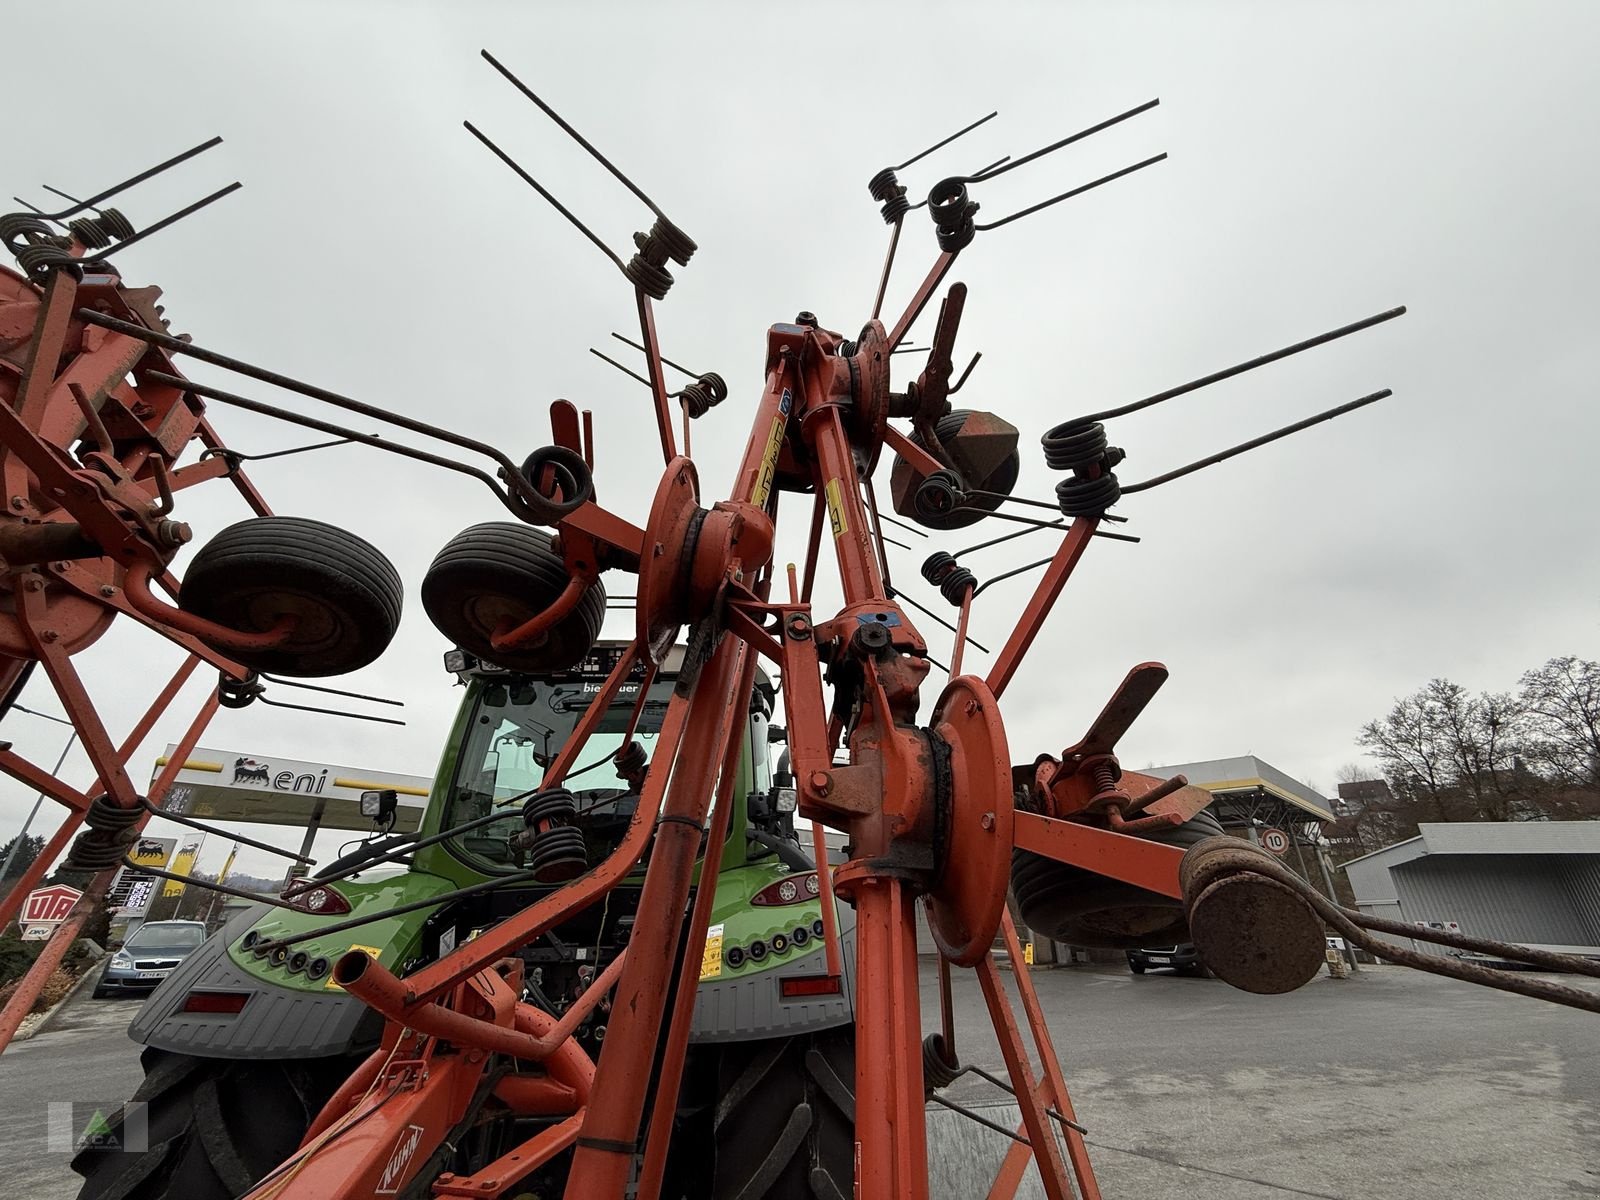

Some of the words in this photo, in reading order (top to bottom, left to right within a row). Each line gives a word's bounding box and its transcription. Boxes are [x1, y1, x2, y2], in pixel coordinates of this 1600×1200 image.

[583, 681, 638, 693] bieuer
[274, 769, 328, 793] eni
[1269, 835, 1282, 847] 10
[24, 888, 80, 921] UTA
[383, 1128, 419, 1191] KUHN
